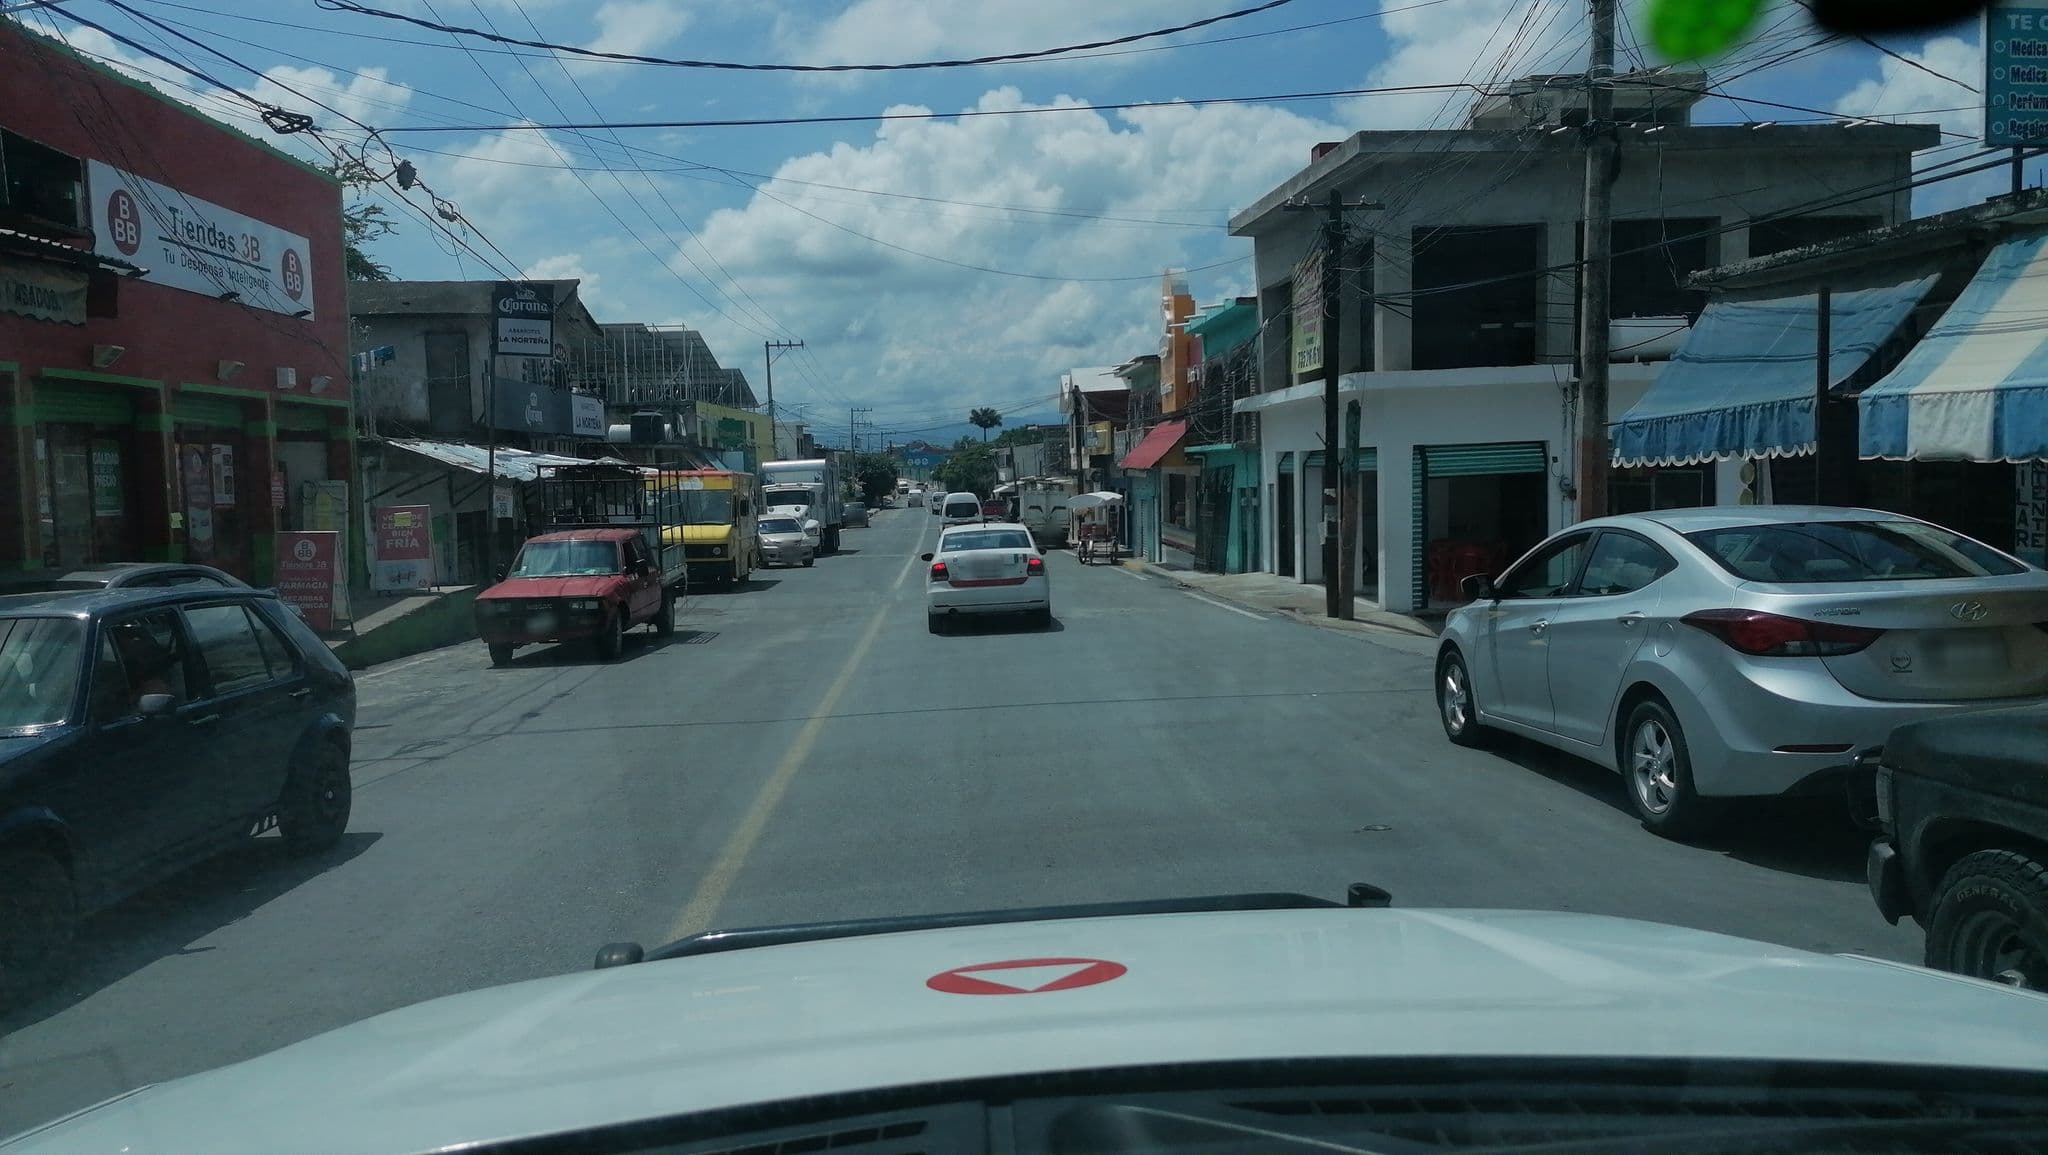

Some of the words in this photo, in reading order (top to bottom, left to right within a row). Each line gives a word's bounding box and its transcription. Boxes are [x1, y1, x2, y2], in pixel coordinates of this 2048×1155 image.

[2007, 14, 2033, 30] TE
[167, 206, 237, 254] Tiendas
[241, 233, 261, 262] 3B
[162, 247, 176, 265] Tu
[180, 255, 225, 280] Despensa
[229, 265, 270, 291] Inteligente
[499, 297, 549, 314] Corona
[499, 336, 510, 344] LA
[511, 336, 551, 345] NORTEÑA
[279, 581, 329, 590] FARMACIA
